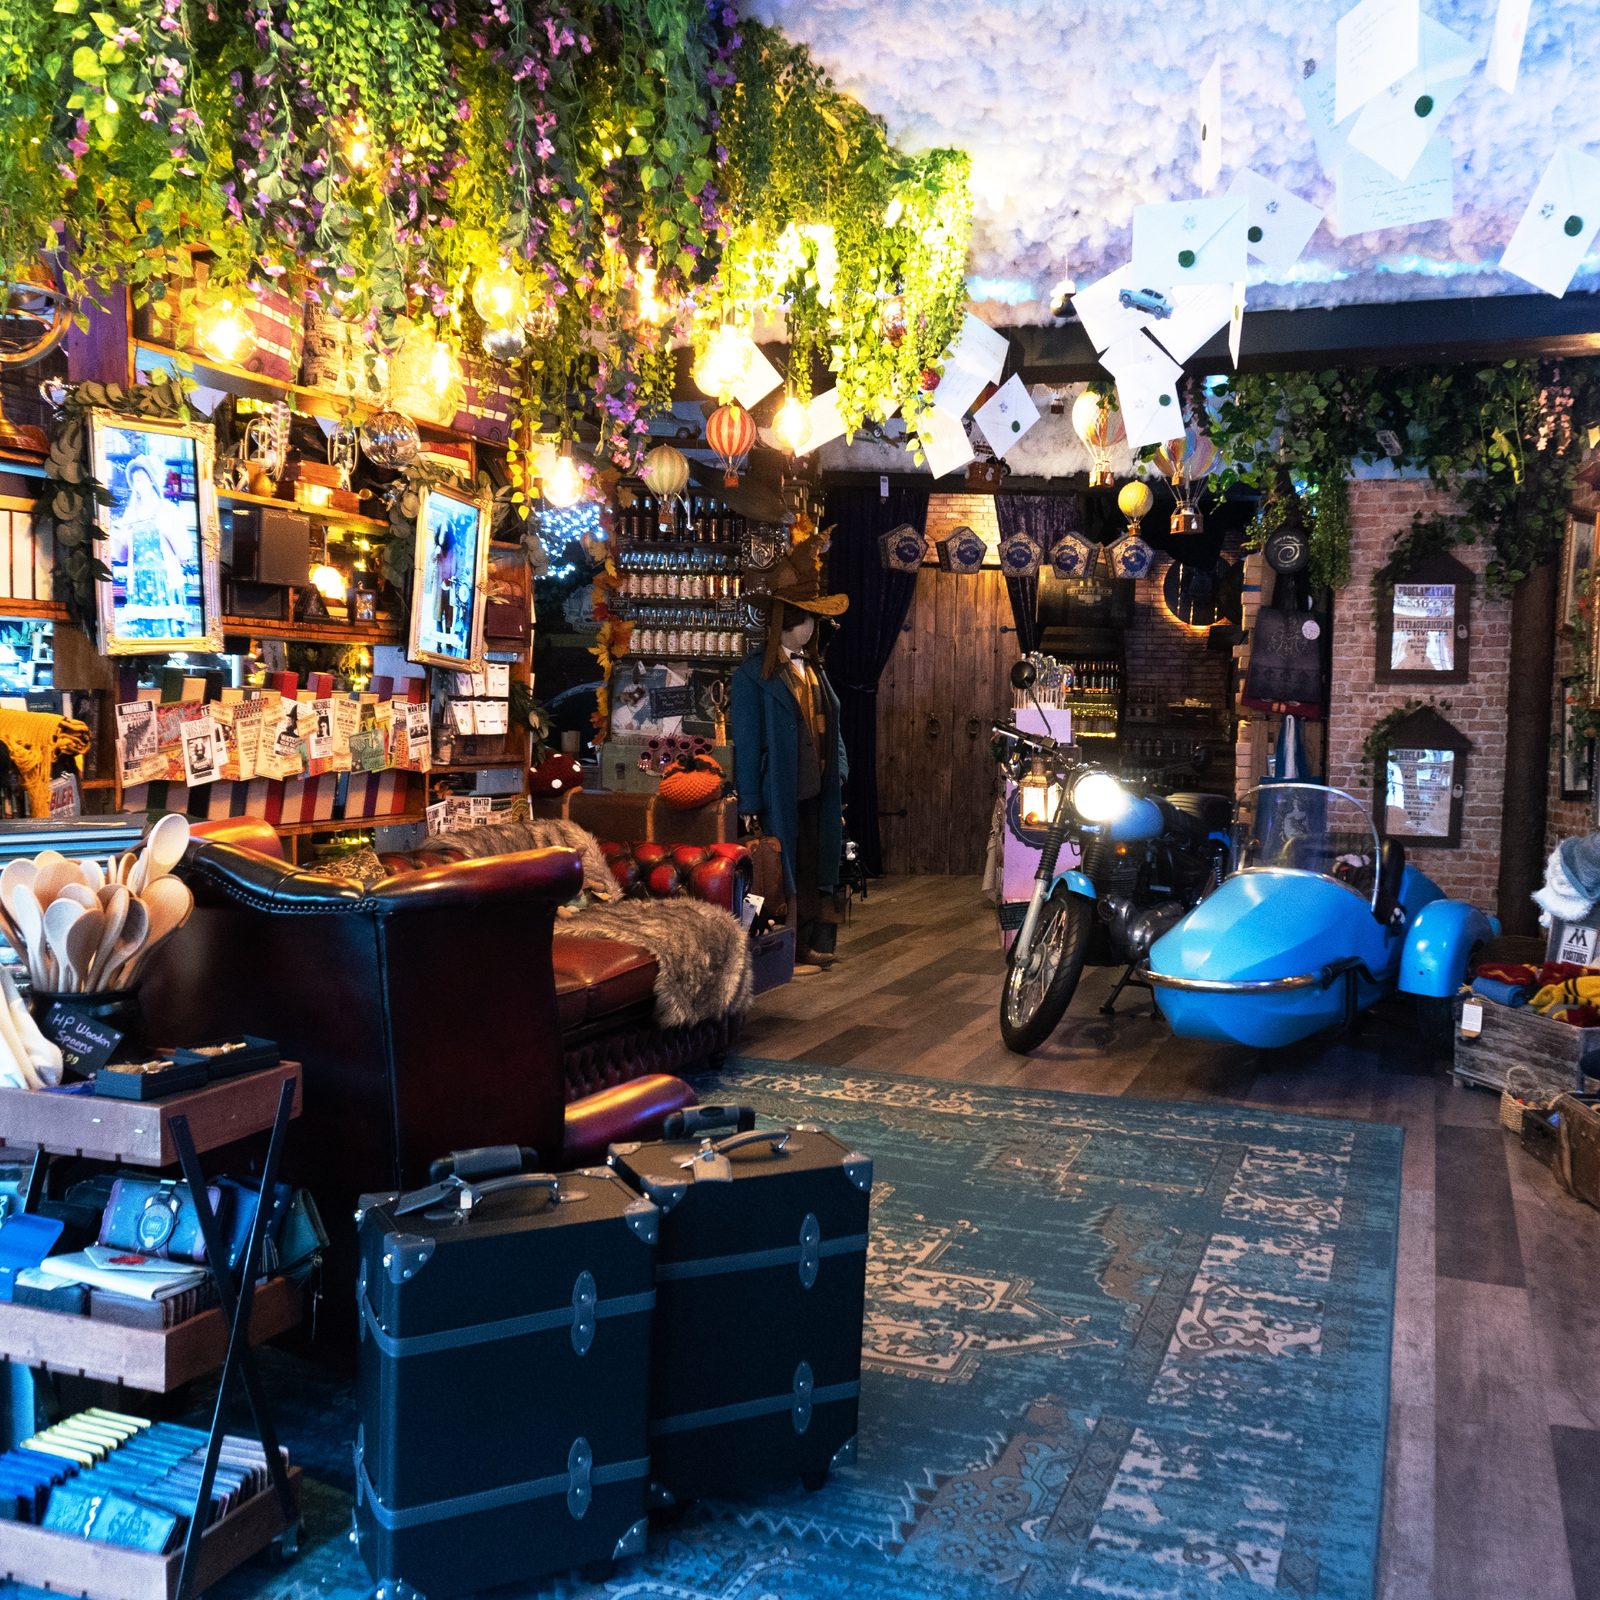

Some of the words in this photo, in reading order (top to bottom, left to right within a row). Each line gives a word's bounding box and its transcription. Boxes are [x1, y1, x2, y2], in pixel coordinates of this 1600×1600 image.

[408, 703, 427, 714] WANTED
[473, 798, 491, 807] WANTED
[1562, 949, 1588, 964] VISITORS
[52, 1013, 75, 1029] HP
[75, 1022, 111, 1048] Wooden
[55, 1030, 94, 1053] Spoons
